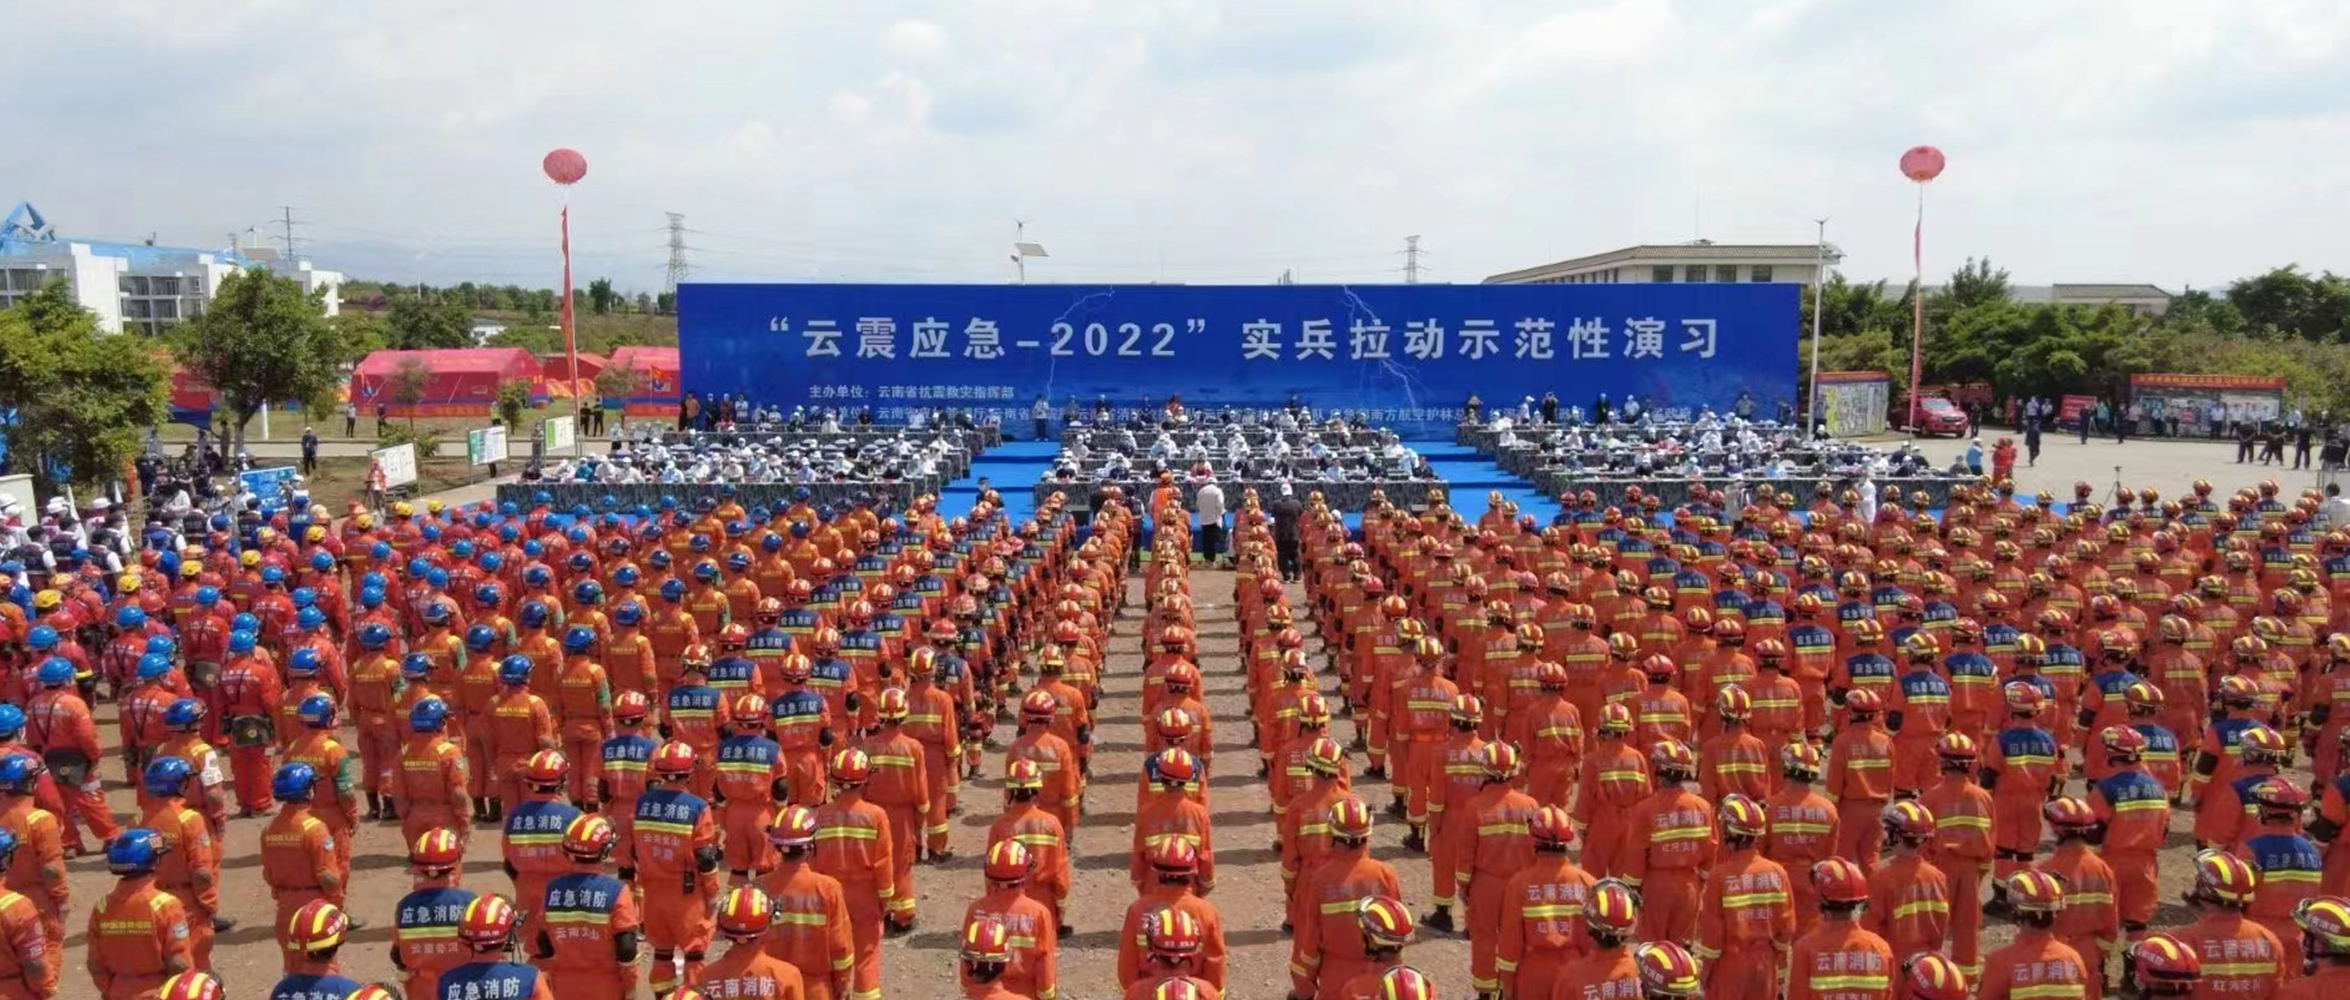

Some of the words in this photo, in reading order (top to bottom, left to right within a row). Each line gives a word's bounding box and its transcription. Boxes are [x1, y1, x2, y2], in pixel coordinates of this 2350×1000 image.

[1242, 316, 1718, 360] 实兵拉动示范性演习
[722, 746, 768, 760] 应急消防
[639, 802, 691, 820] 应急消防
[512, 815, 563, 831] 应急消防
[548, 888, 608, 908] 应急消防
[401, 904, 464, 925] 应急消防
[1816, 952, 1884, 972] 云南消防
[448, 977, 521, 1000] 应急消防
[705, 976, 776, 997] 云南消防
